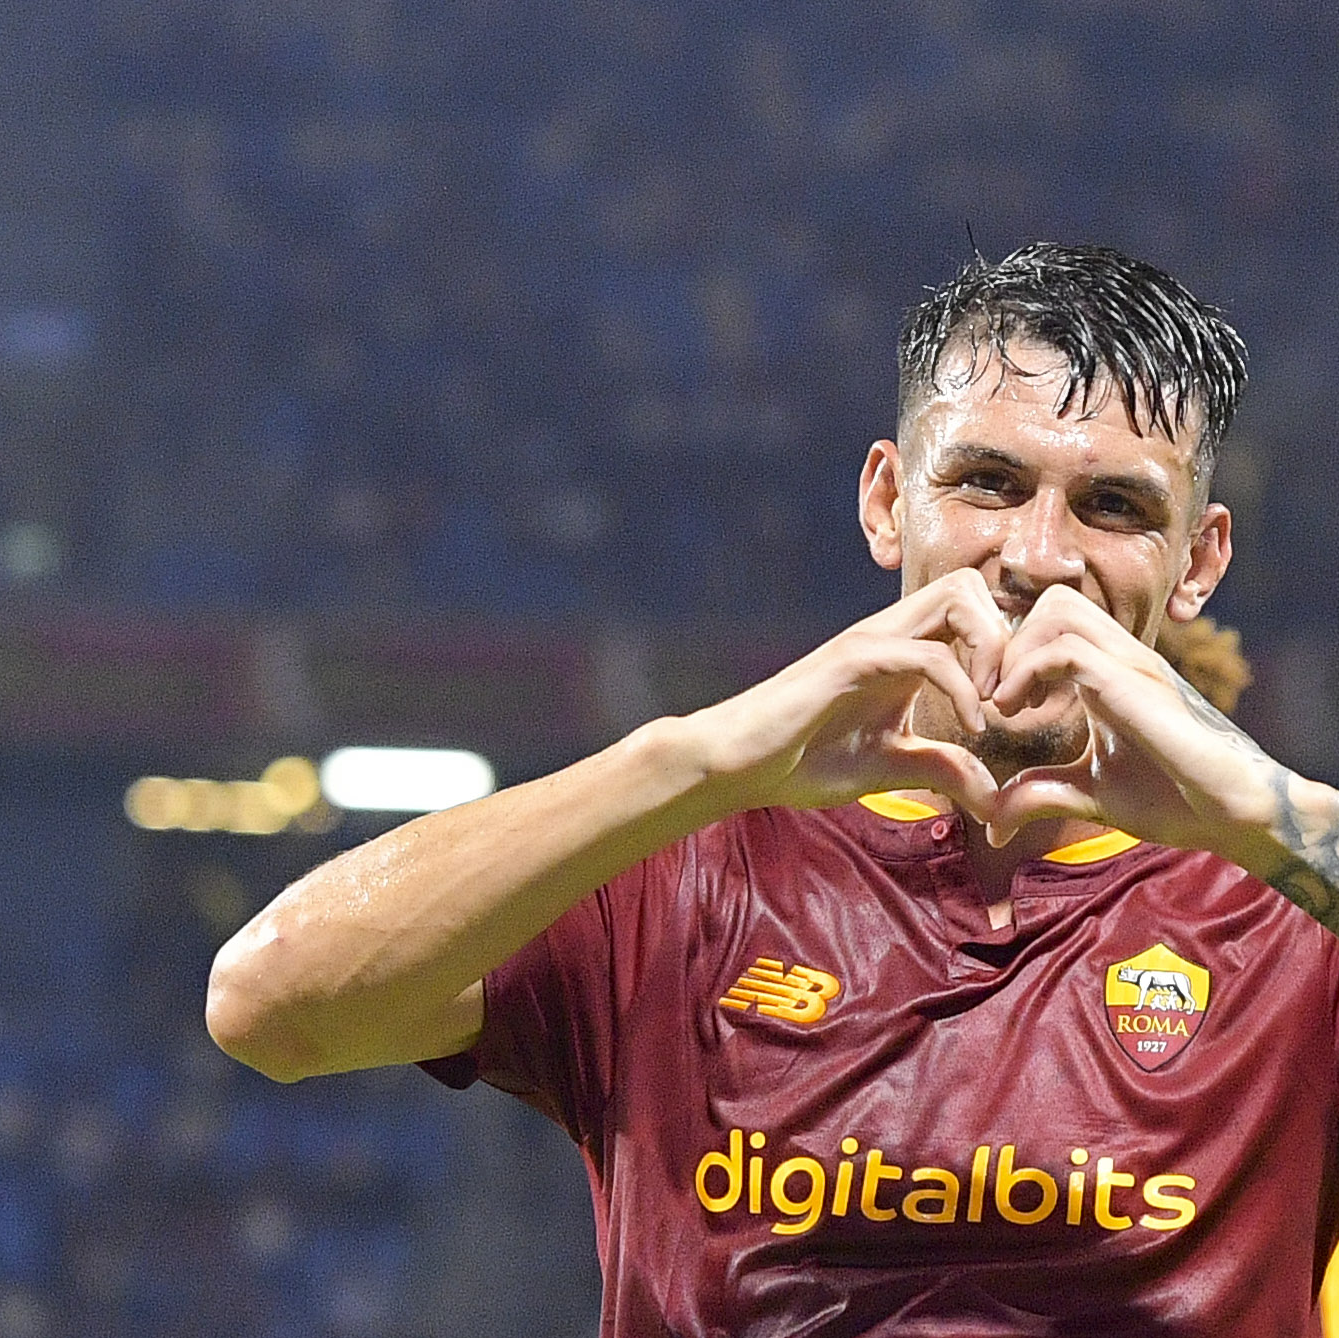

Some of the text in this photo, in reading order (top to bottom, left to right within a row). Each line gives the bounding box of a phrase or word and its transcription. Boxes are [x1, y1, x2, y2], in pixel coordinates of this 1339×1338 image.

[1116, 1014, 1190, 1038] ROMA
[1137, 1041, 1167, 1052] 1927
[695, 1129, 1197, 1235] digitalbits
